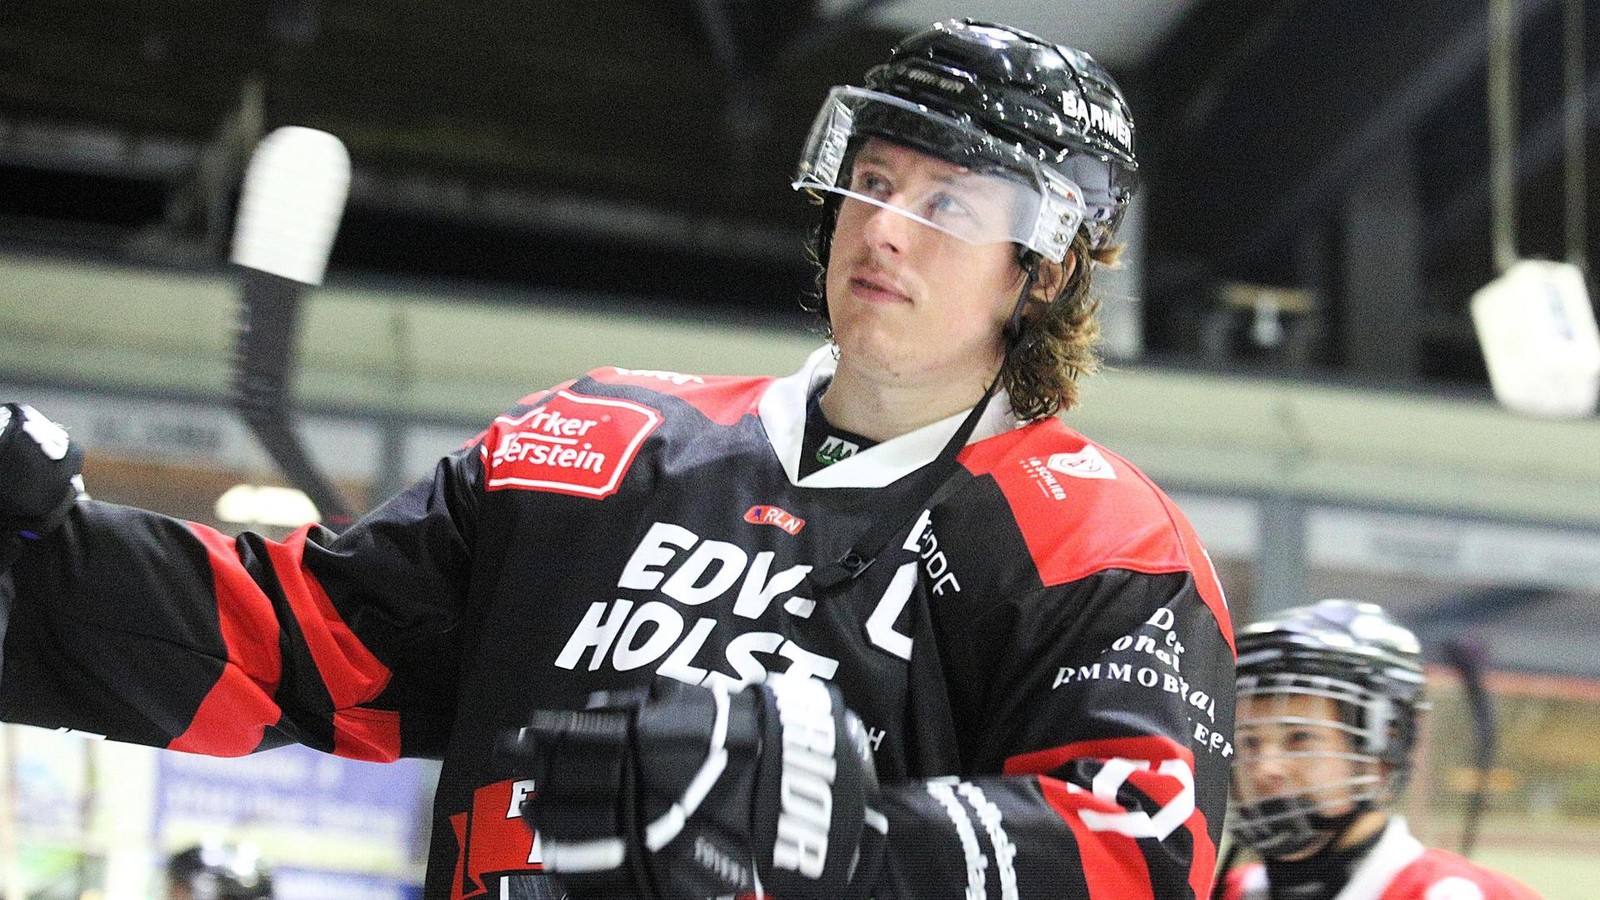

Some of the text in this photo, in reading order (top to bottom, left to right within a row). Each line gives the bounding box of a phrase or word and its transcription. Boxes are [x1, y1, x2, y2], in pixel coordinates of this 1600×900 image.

[763, 508, 802, 532] RLN
[618, 521, 817, 620] EDV-
[554, 598, 840, 693] HOLST
